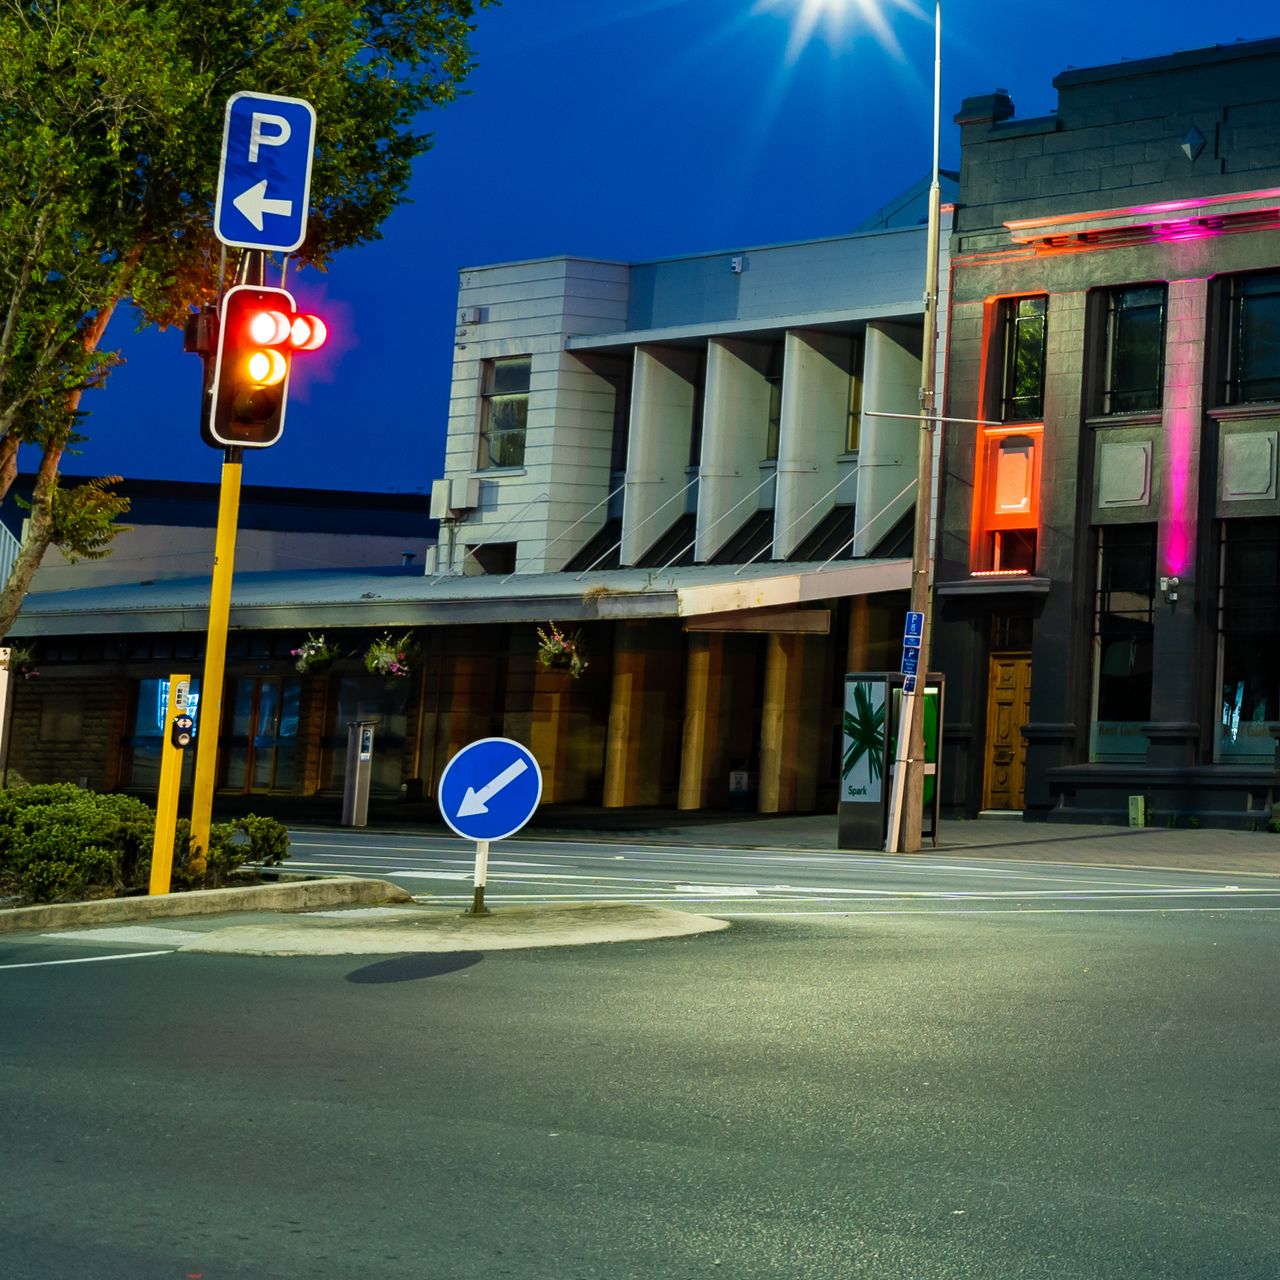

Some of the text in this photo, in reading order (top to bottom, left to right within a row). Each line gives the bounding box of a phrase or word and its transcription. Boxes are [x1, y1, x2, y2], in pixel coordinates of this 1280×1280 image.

[248, 111, 292, 163] P
[912, 614, 918, 623] P
[848, 785, 867, 797] Spark
